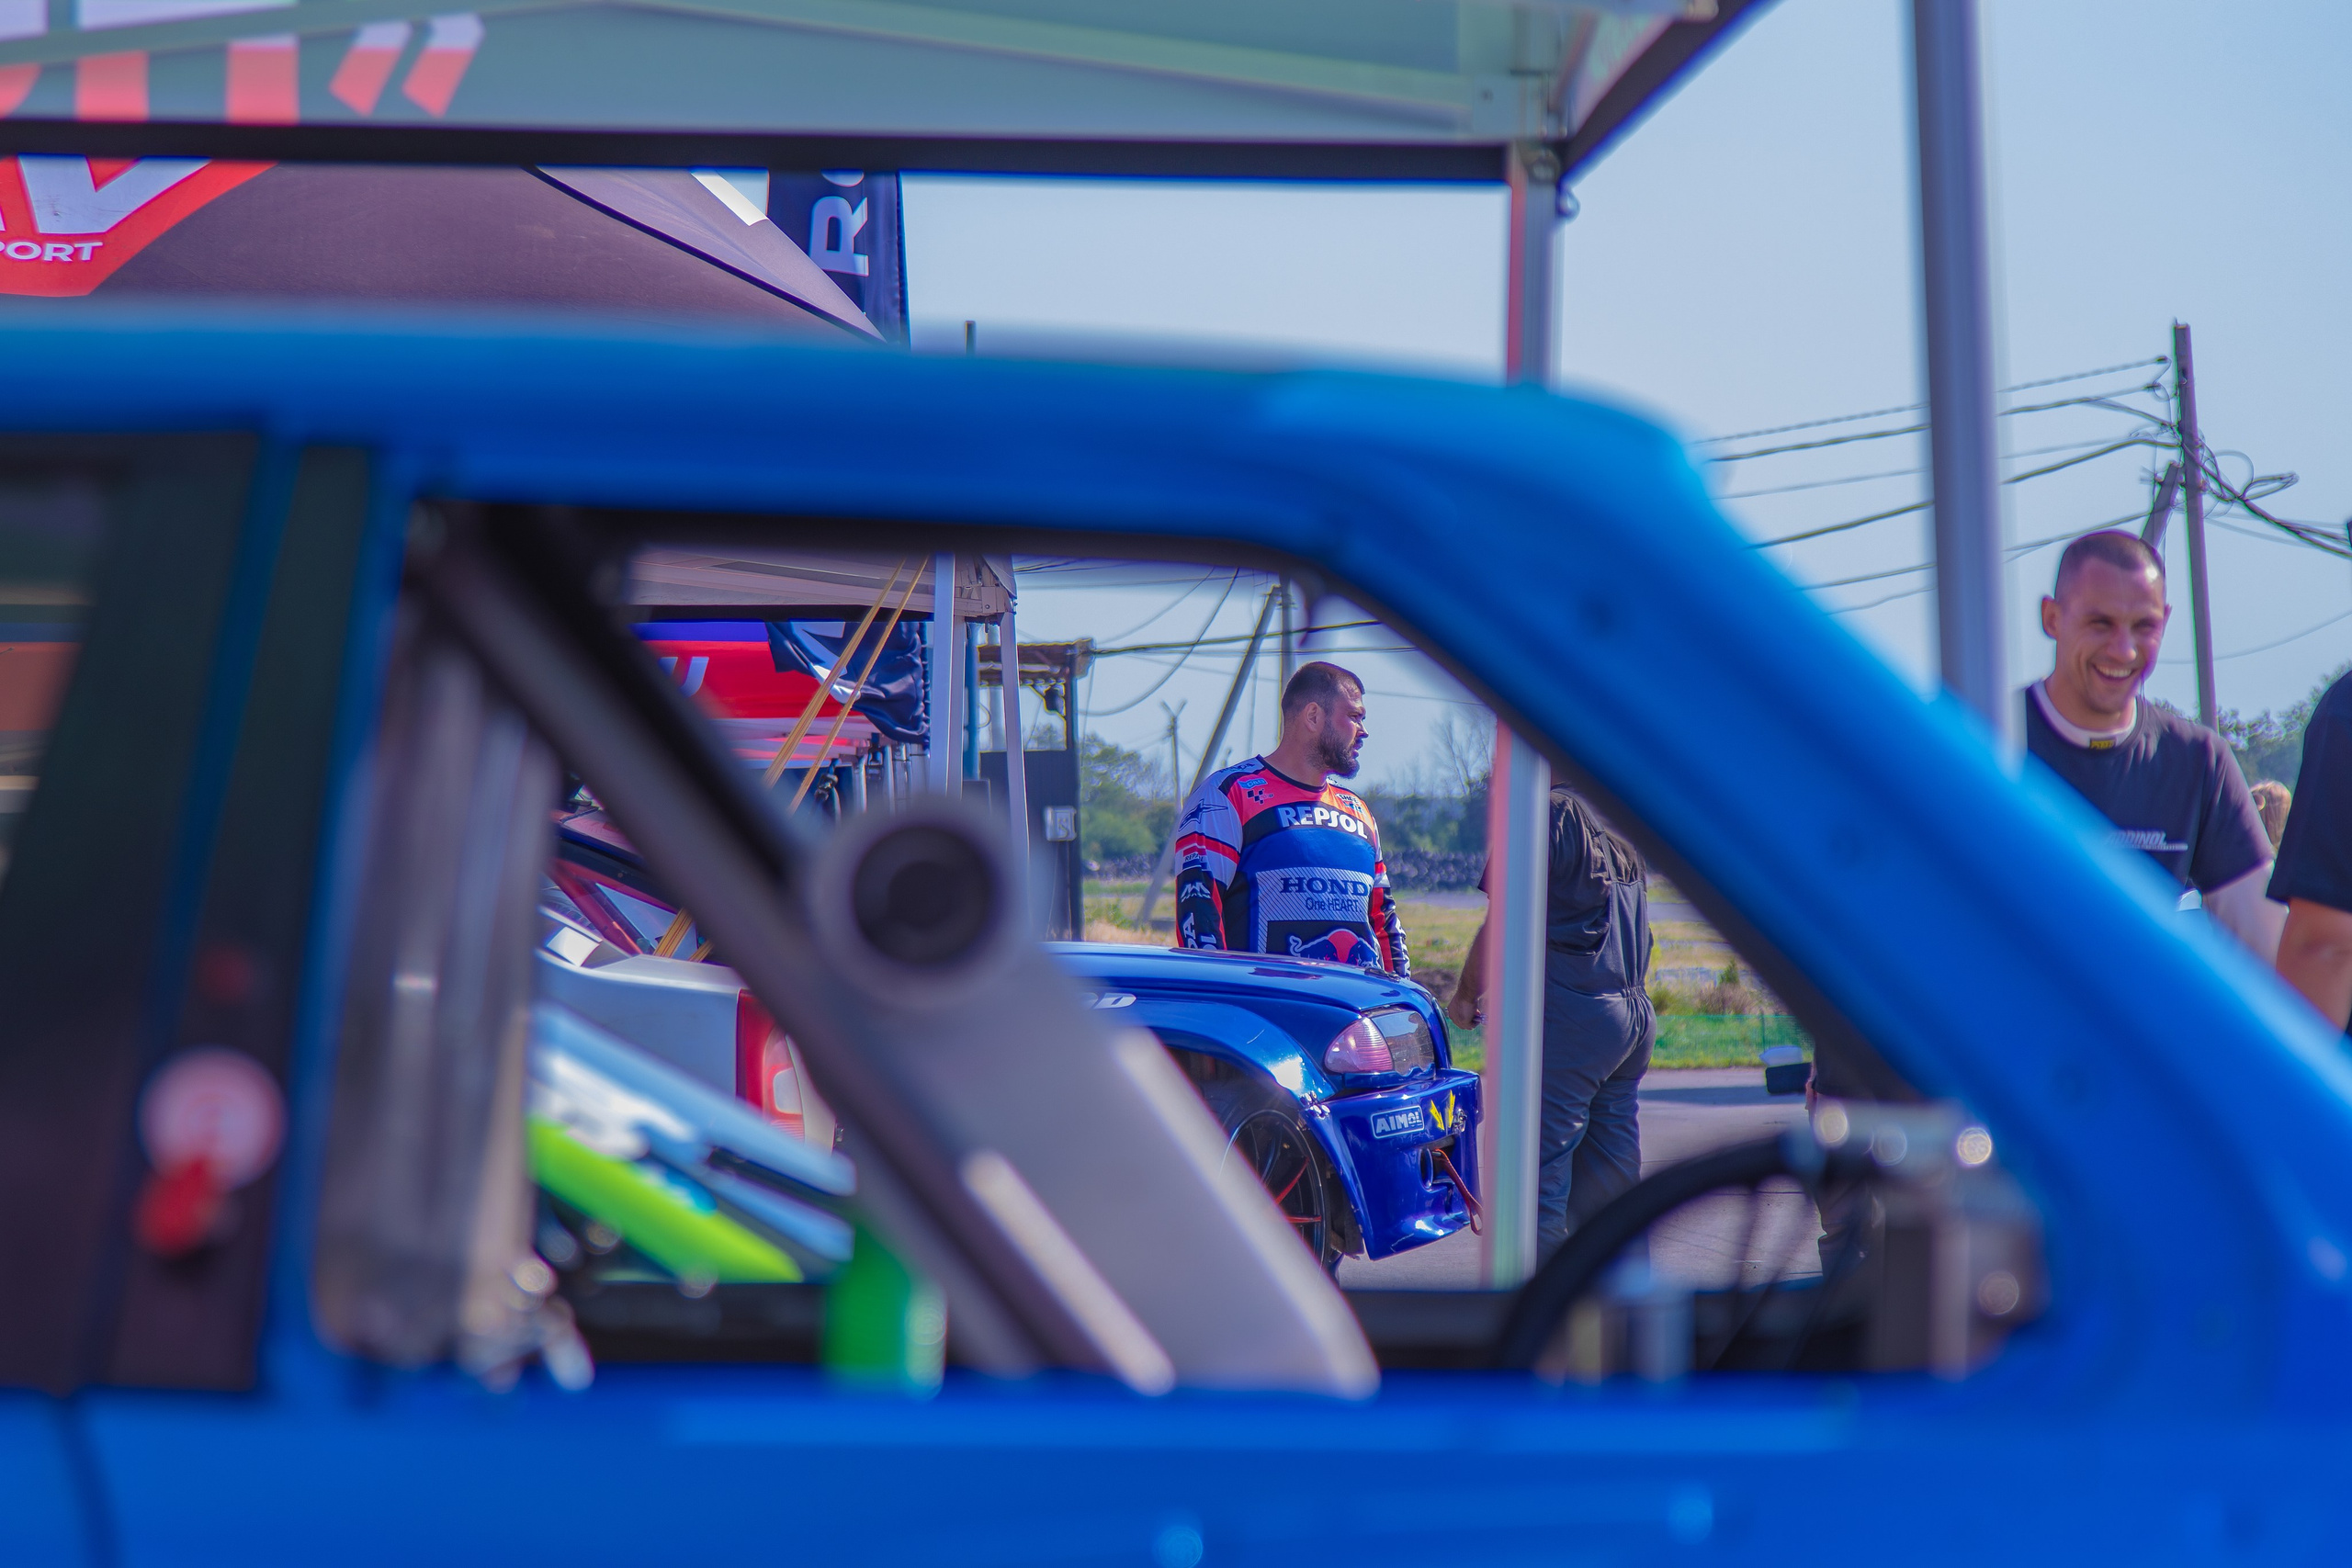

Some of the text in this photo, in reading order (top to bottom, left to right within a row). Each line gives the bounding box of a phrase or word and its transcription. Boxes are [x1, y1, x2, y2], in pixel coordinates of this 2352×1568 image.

[1278, 806, 1368, 839] REPSOL
[1279, 876, 1373, 897] HOND
[1305, 897, 1326, 910] One
[1375, 1111, 1422, 1134] AIMOL
